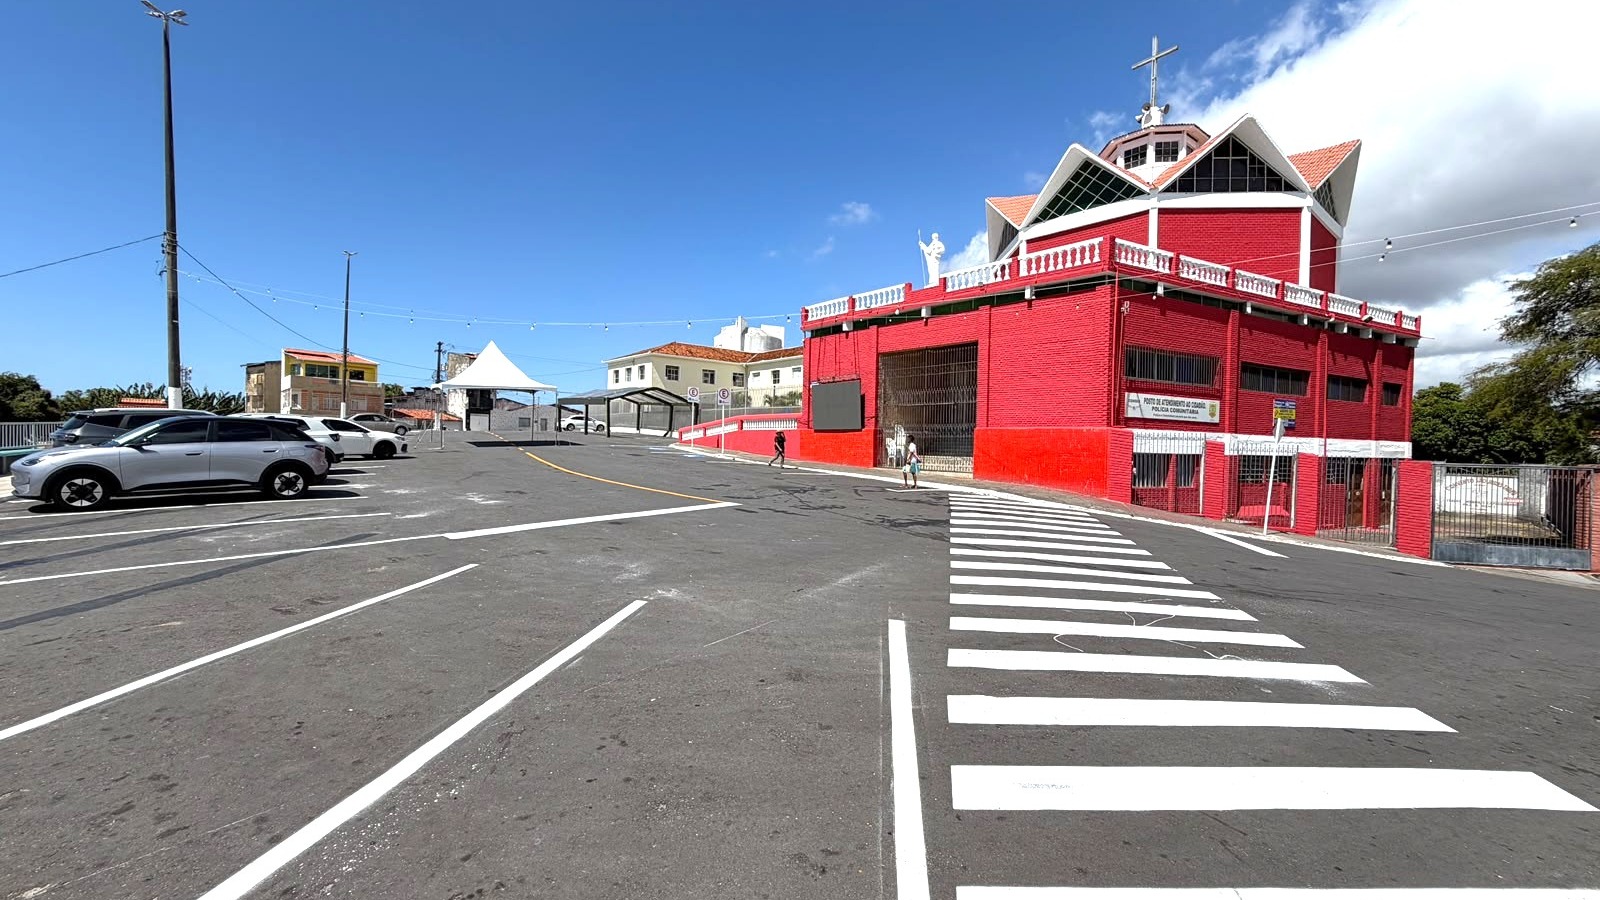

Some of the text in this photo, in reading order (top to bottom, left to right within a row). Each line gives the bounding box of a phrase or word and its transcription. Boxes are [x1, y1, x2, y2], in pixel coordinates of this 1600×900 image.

[1144, 397, 1155, 405] POSTO
[1156, 398, 1161, 406] DE
[1162, 399, 1185, 407] ATENDIMENTO
